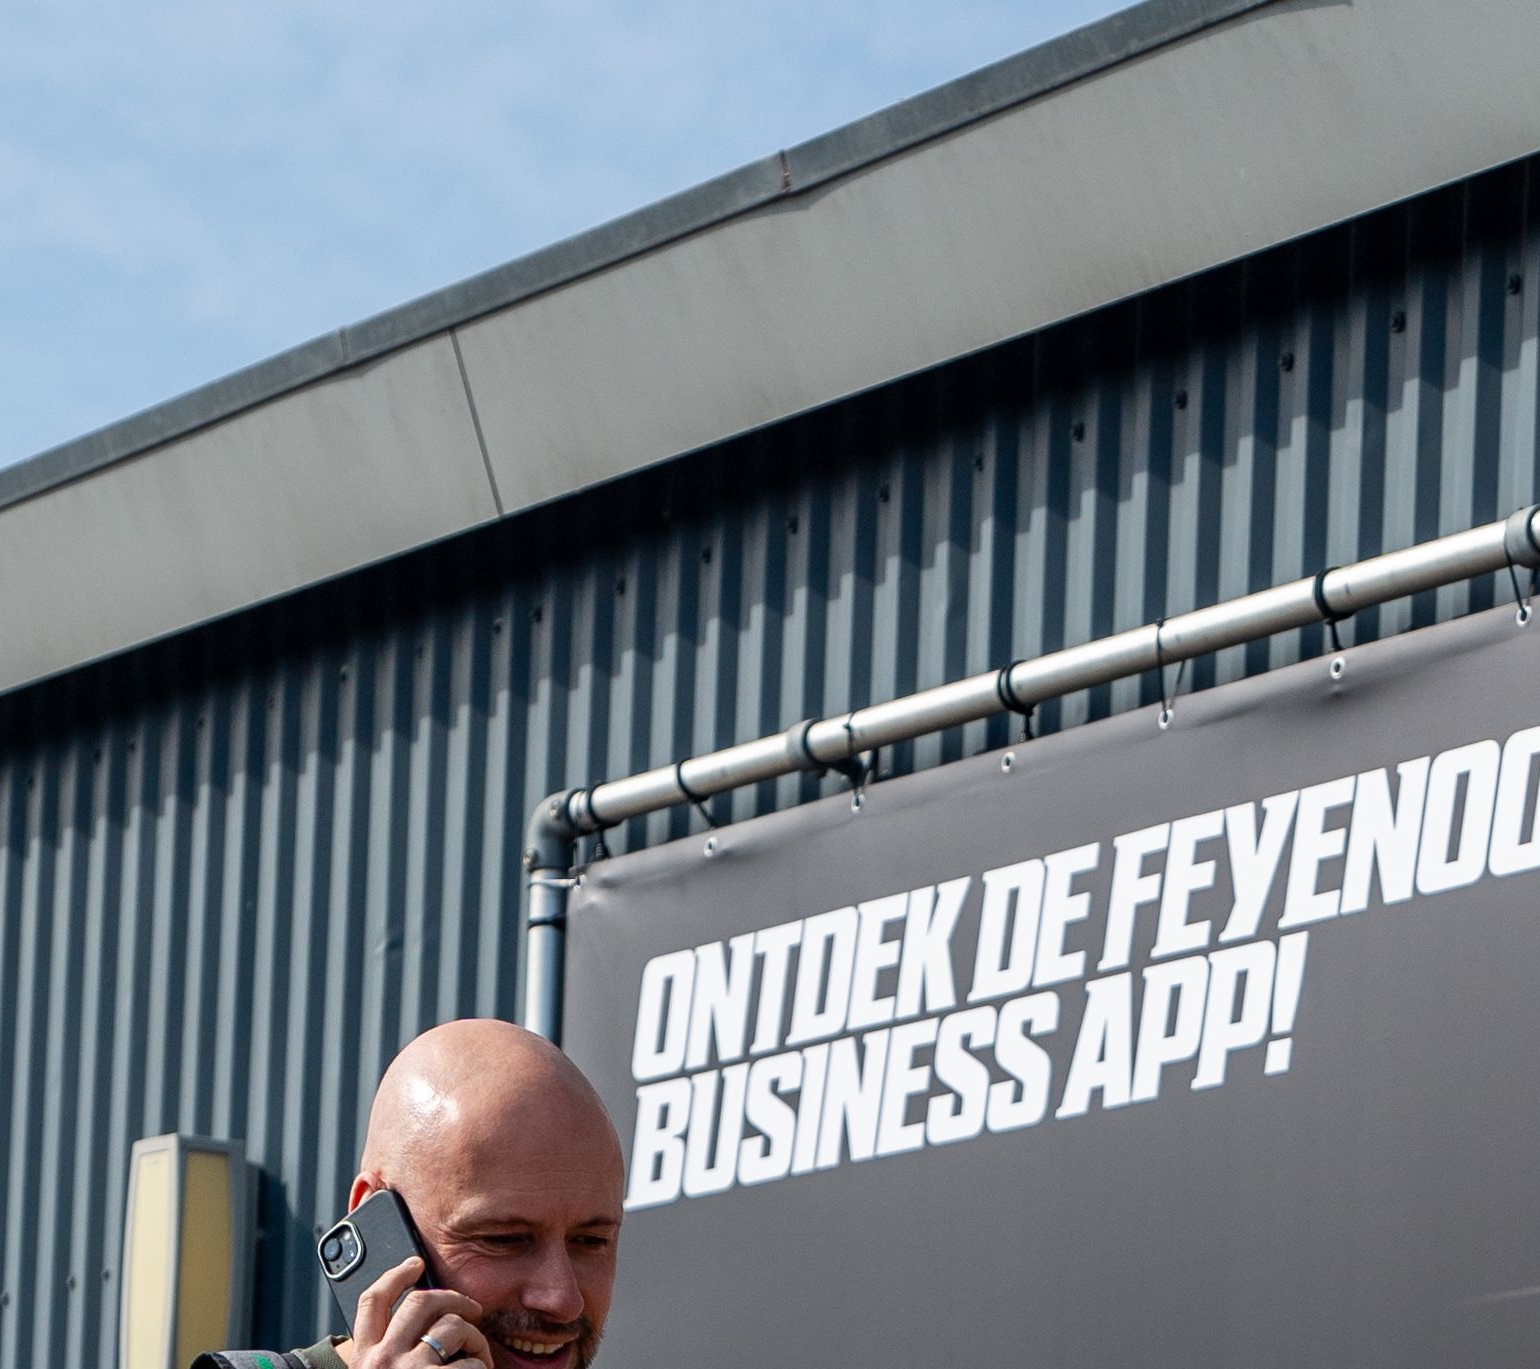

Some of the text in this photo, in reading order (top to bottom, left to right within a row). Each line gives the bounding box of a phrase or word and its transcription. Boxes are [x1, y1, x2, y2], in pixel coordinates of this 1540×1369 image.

[623, 931, 1309, 1212] BUSINESS APP!
[631, 876, 971, 1082] ONTDEK
[967, 842, 1101, 1003] DE
